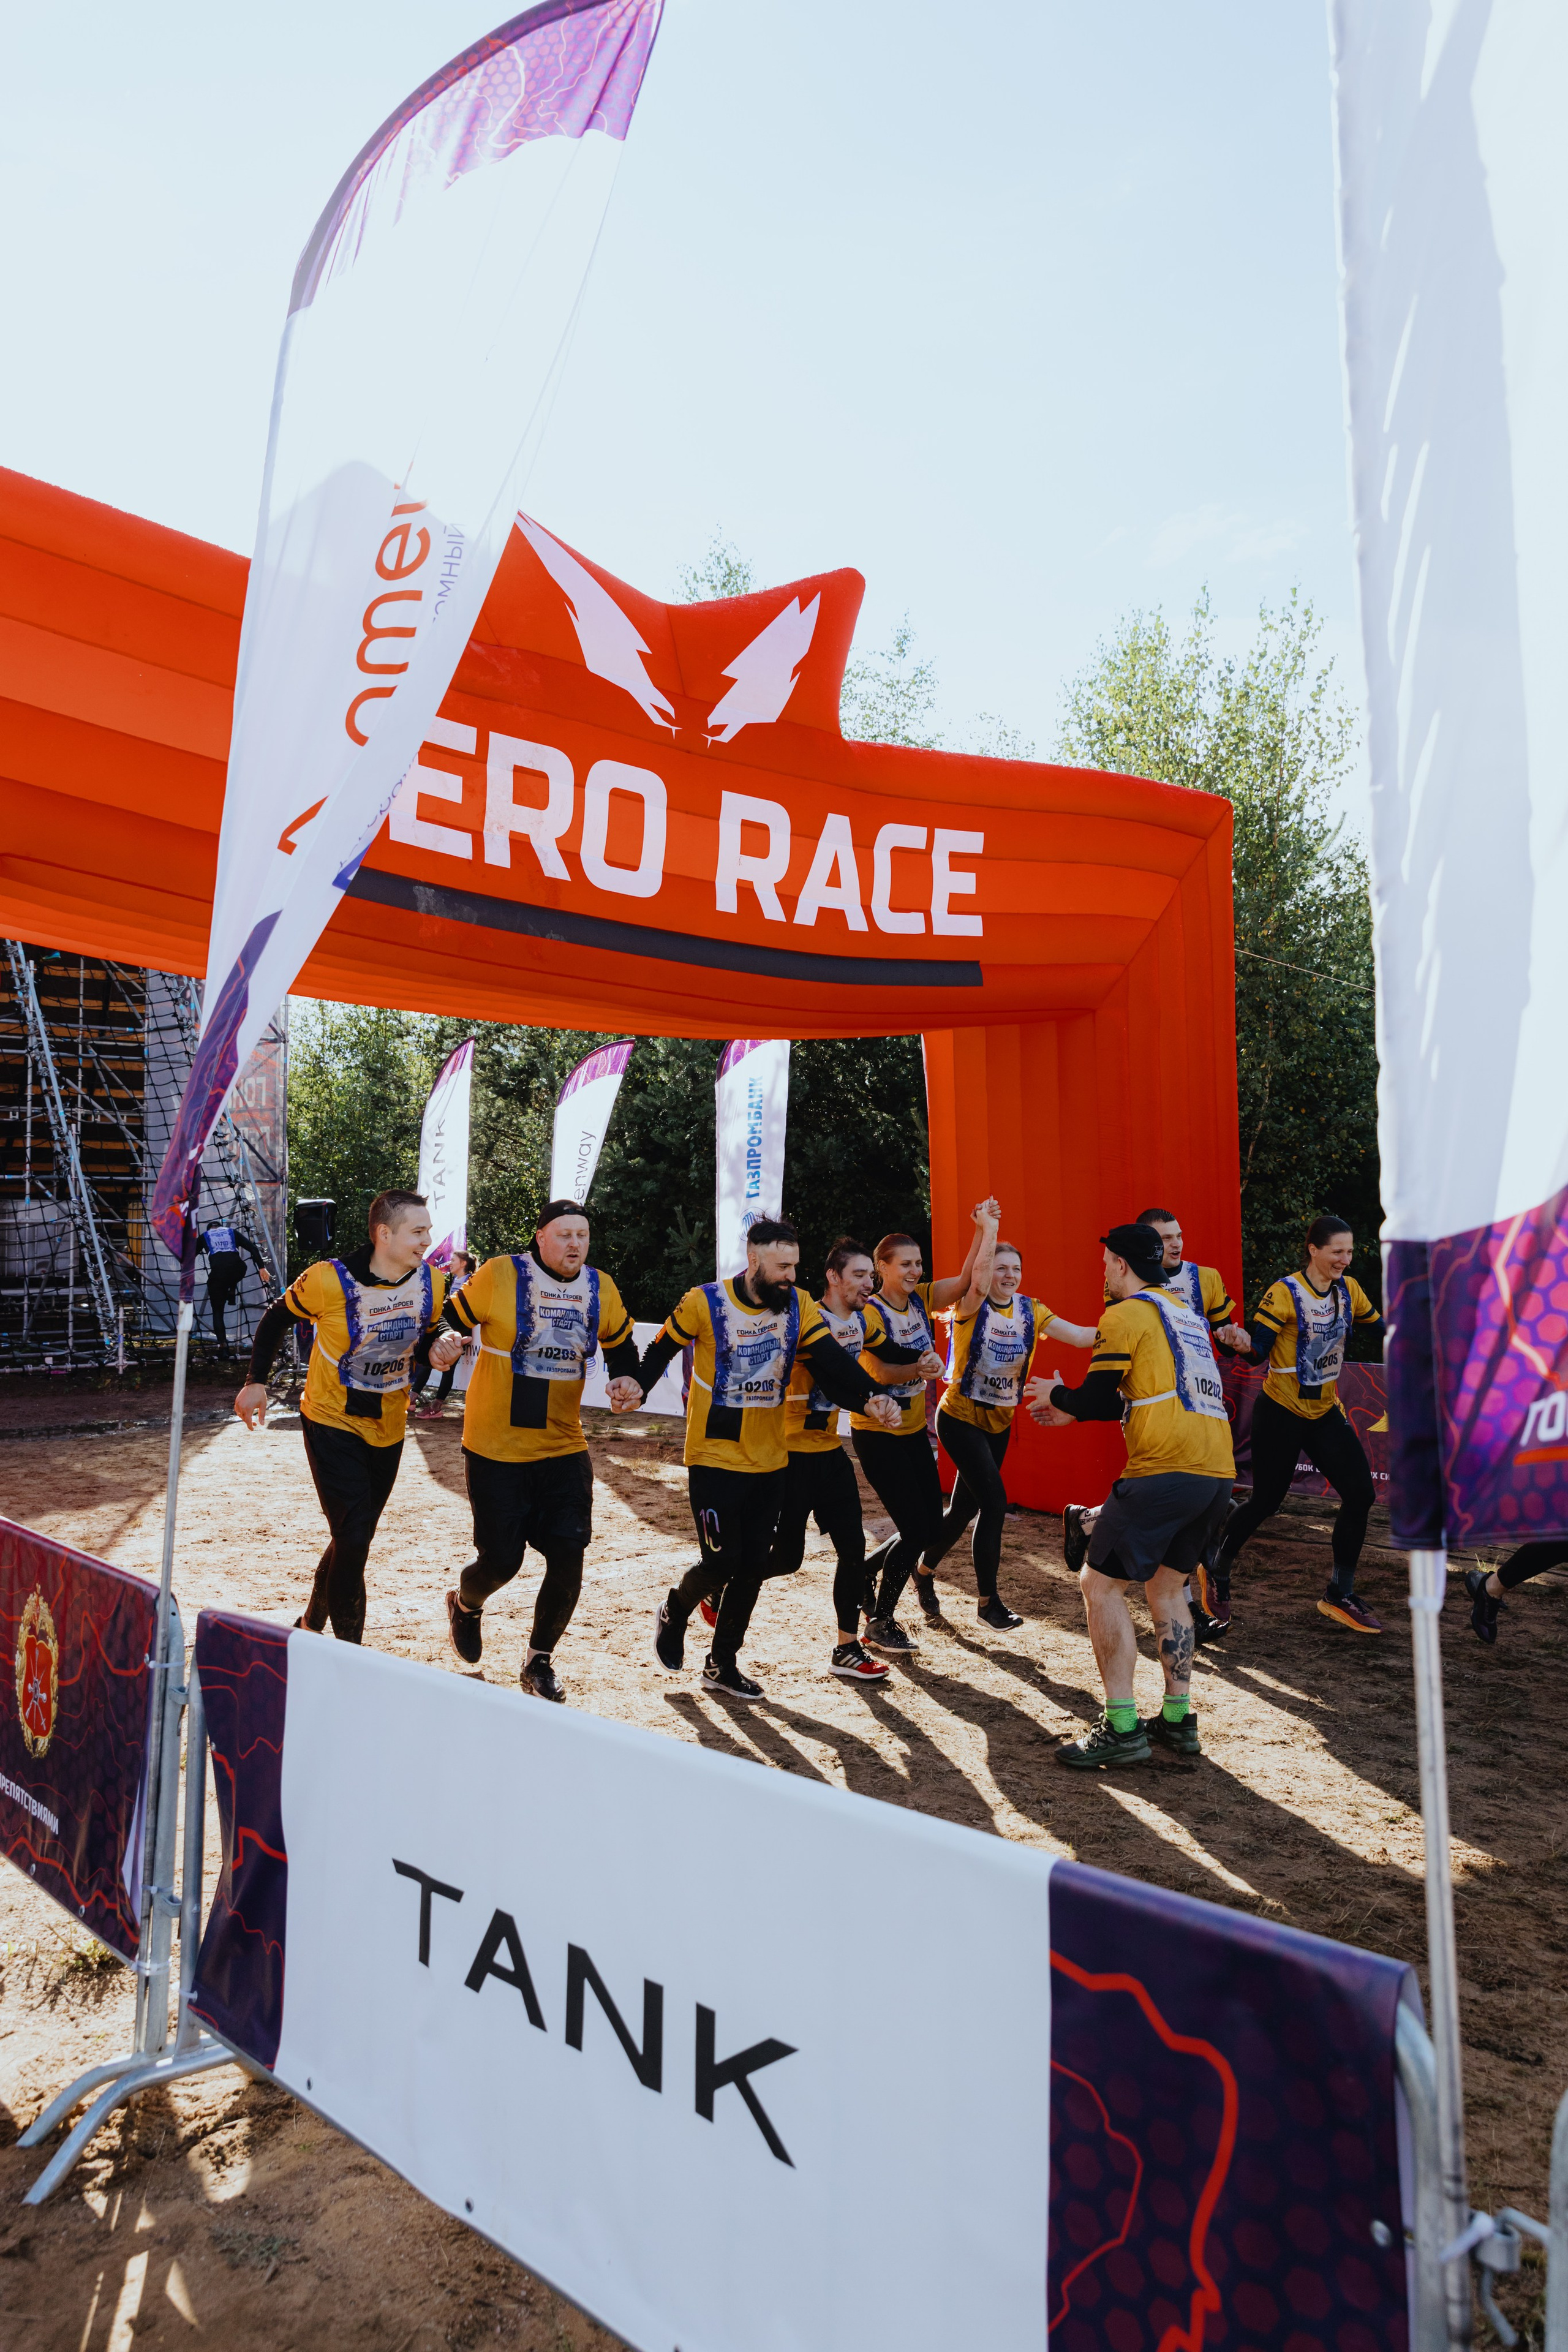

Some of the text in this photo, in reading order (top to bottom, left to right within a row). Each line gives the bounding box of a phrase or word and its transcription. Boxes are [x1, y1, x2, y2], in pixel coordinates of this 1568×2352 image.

[389, 715, 668, 899] ERO
[715, 790, 985, 937] RACE
[745, 1074, 764, 1199] ГАЗПРОМБАНК
[432, 1117, 446, 1210] TANK
[573, 1131, 597, 1206] enway
[540, 1290, 561, 1299] ГОНКА
[369, 1305, 391, 1314] ГОНКА
[540, 1307, 584, 1323] КОМАНДНЫЙ
[552, 1319, 572, 1329] СТАРТ
[758, 1322, 778, 1334] ГЕРОЕВ
[380, 1330, 403, 1341] СТАРТ
[738, 1337, 781, 1356] КОМАНДНЫЙ
[1194, 1347, 1211, 1359] СТАРТ
[363, 1357, 405, 1376] 10206
[748, 1352, 771, 1365] СТАРТ
[1313, 1353, 1338, 1371] 10205
[738, 1379, 775, 1393] 10208
[984, 1375, 1013, 1390] 10204
[1194, 1377, 1221, 1400] 10202
[1519, 1390, 1568, 1447] ГО
[391, 1857, 799, 2170] TANK
